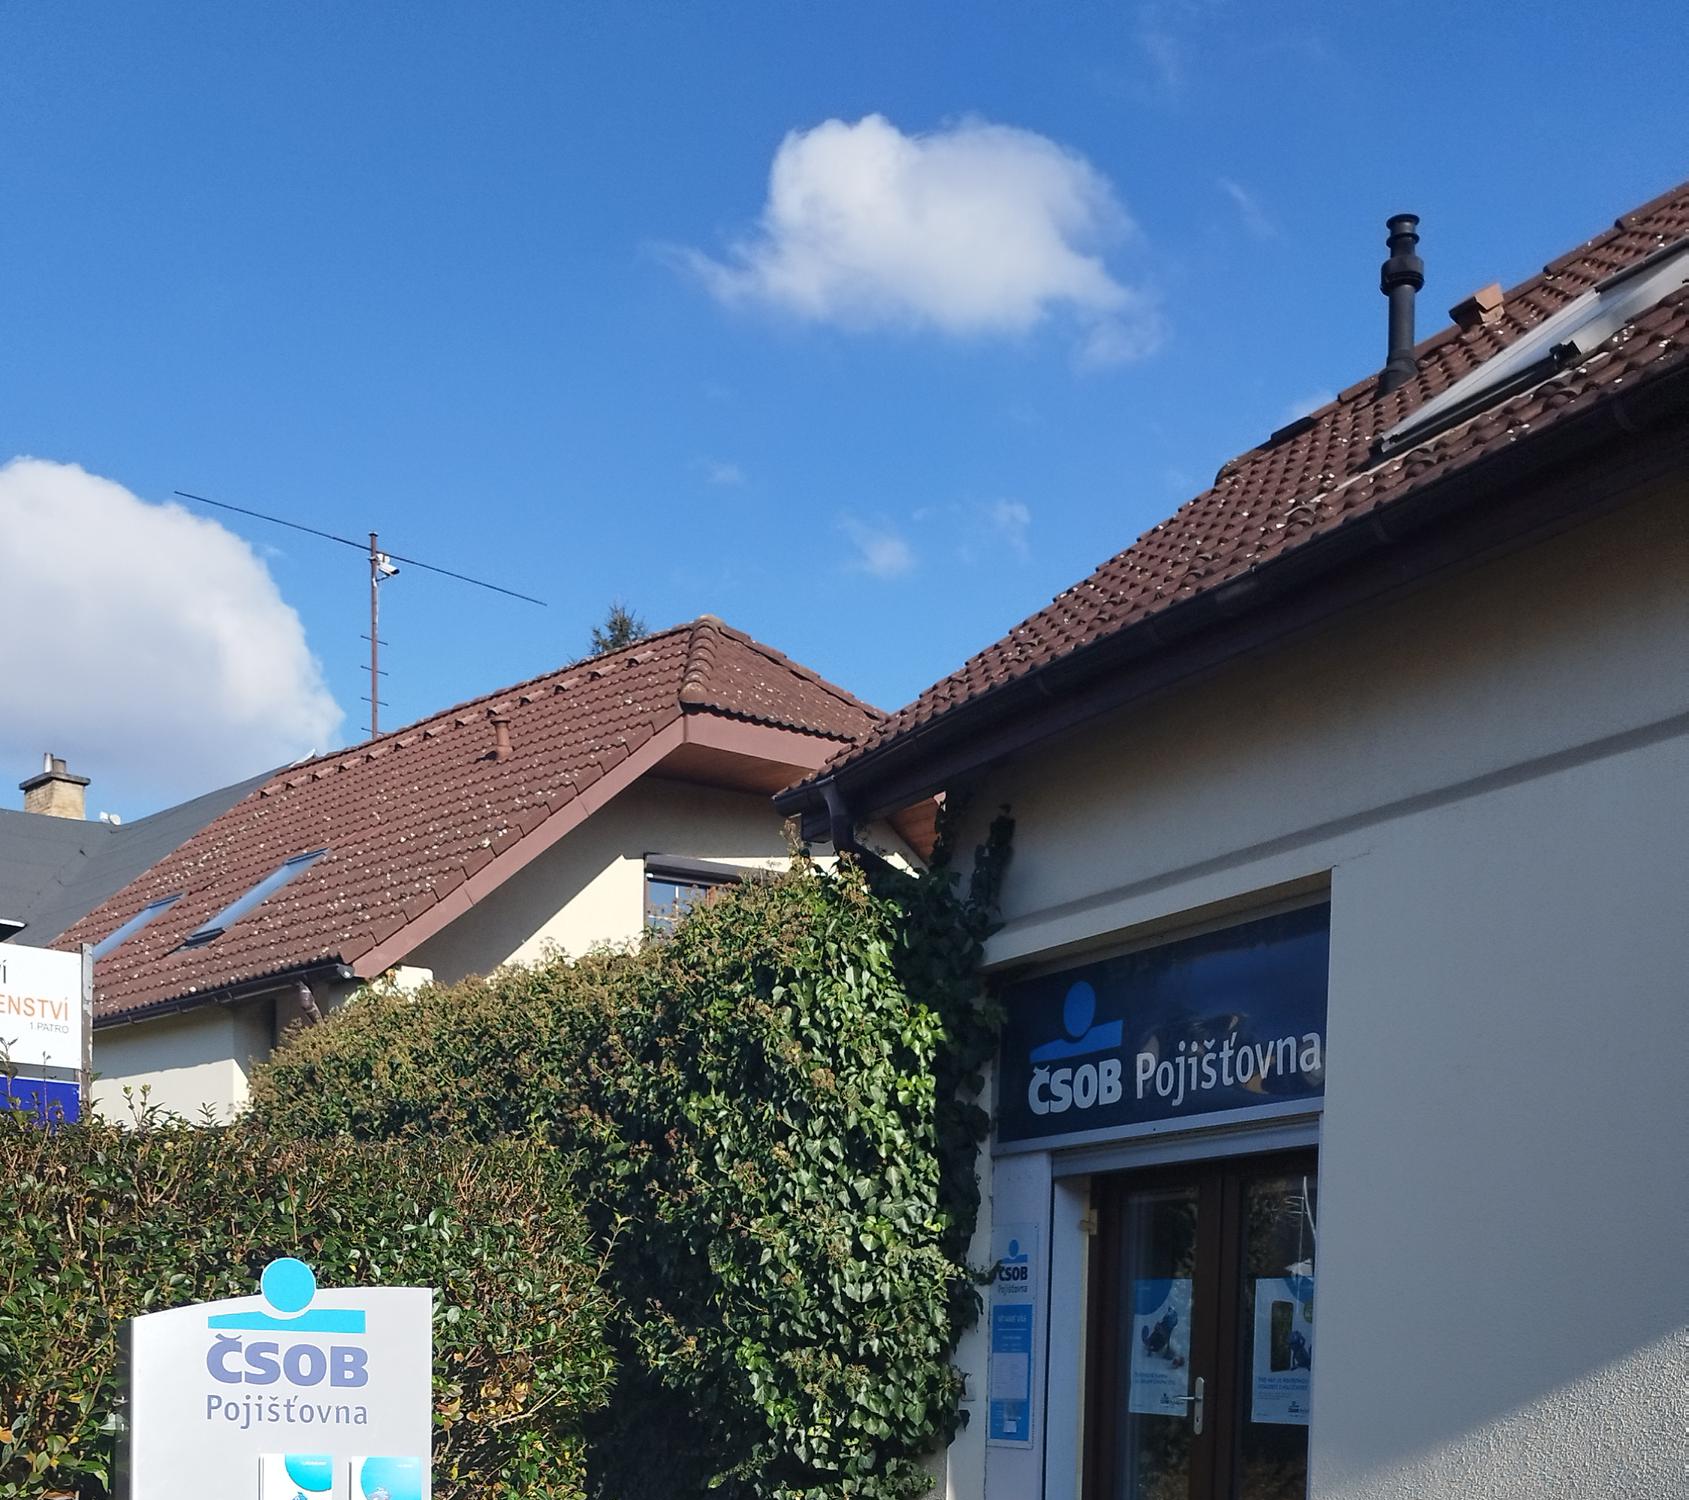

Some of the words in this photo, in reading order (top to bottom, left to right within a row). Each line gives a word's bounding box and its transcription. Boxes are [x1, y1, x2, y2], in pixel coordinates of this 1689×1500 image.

[1028, 1058, 1122, 1116] ČSOB
[1136, 1031, 1322, 1106] Pojišťovna
[206, 1333, 369, 1388] ČSOB
[206, 1394, 368, 1429] Pojišťovna
